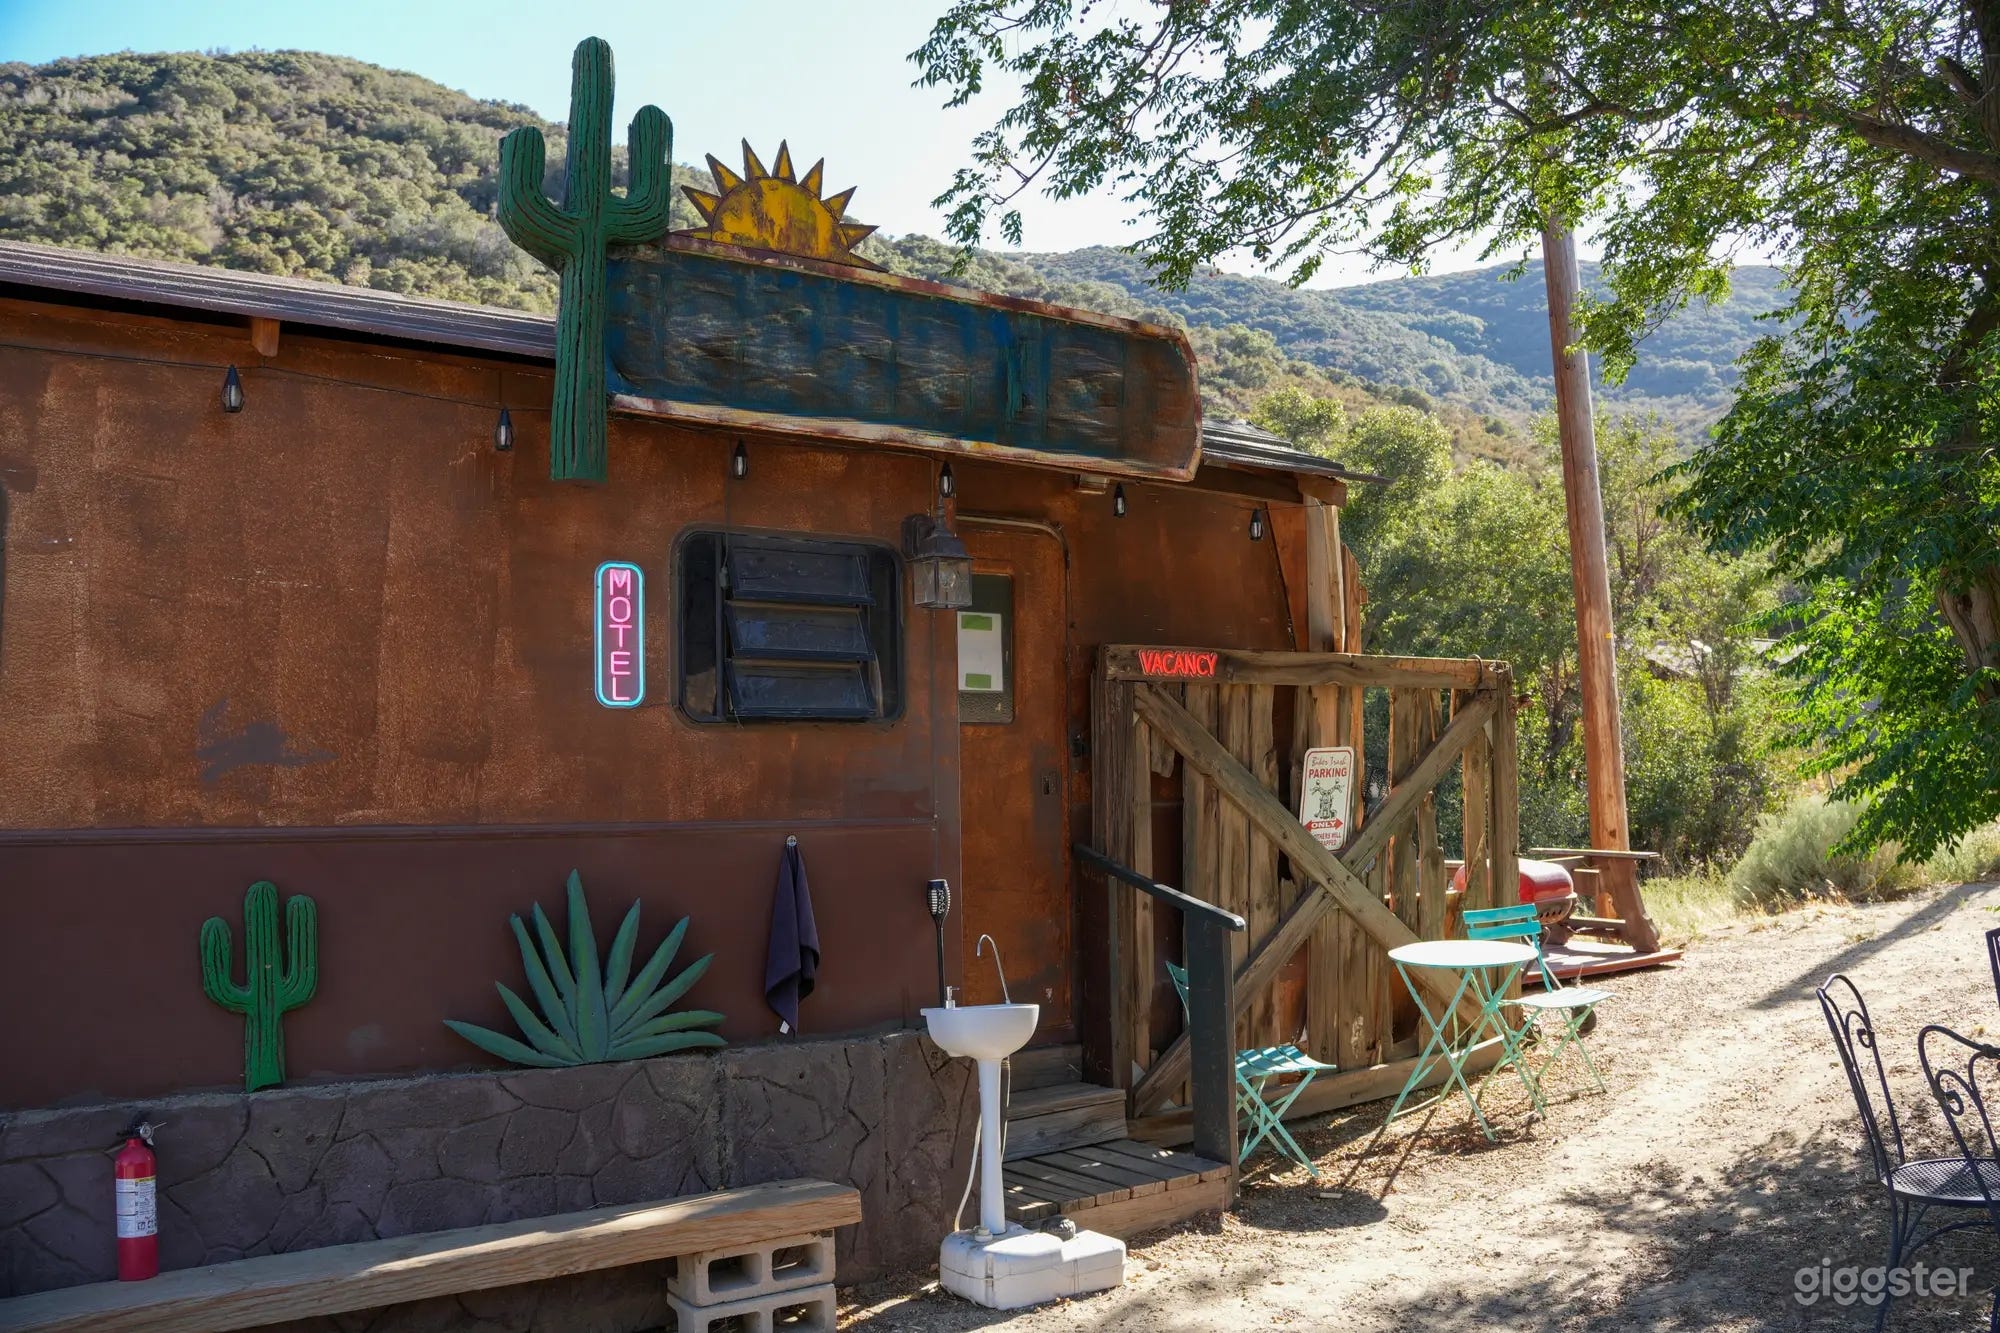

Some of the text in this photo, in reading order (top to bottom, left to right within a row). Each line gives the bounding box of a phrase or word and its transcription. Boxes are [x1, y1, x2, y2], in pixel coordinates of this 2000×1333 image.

[609, 568, 632, 701] MOTEL
[1140, 651, 1218, 676] VACANCY
[1308, 767, 1347, 778] PARKING
[1311, 821, 1337, 829] ONLY
